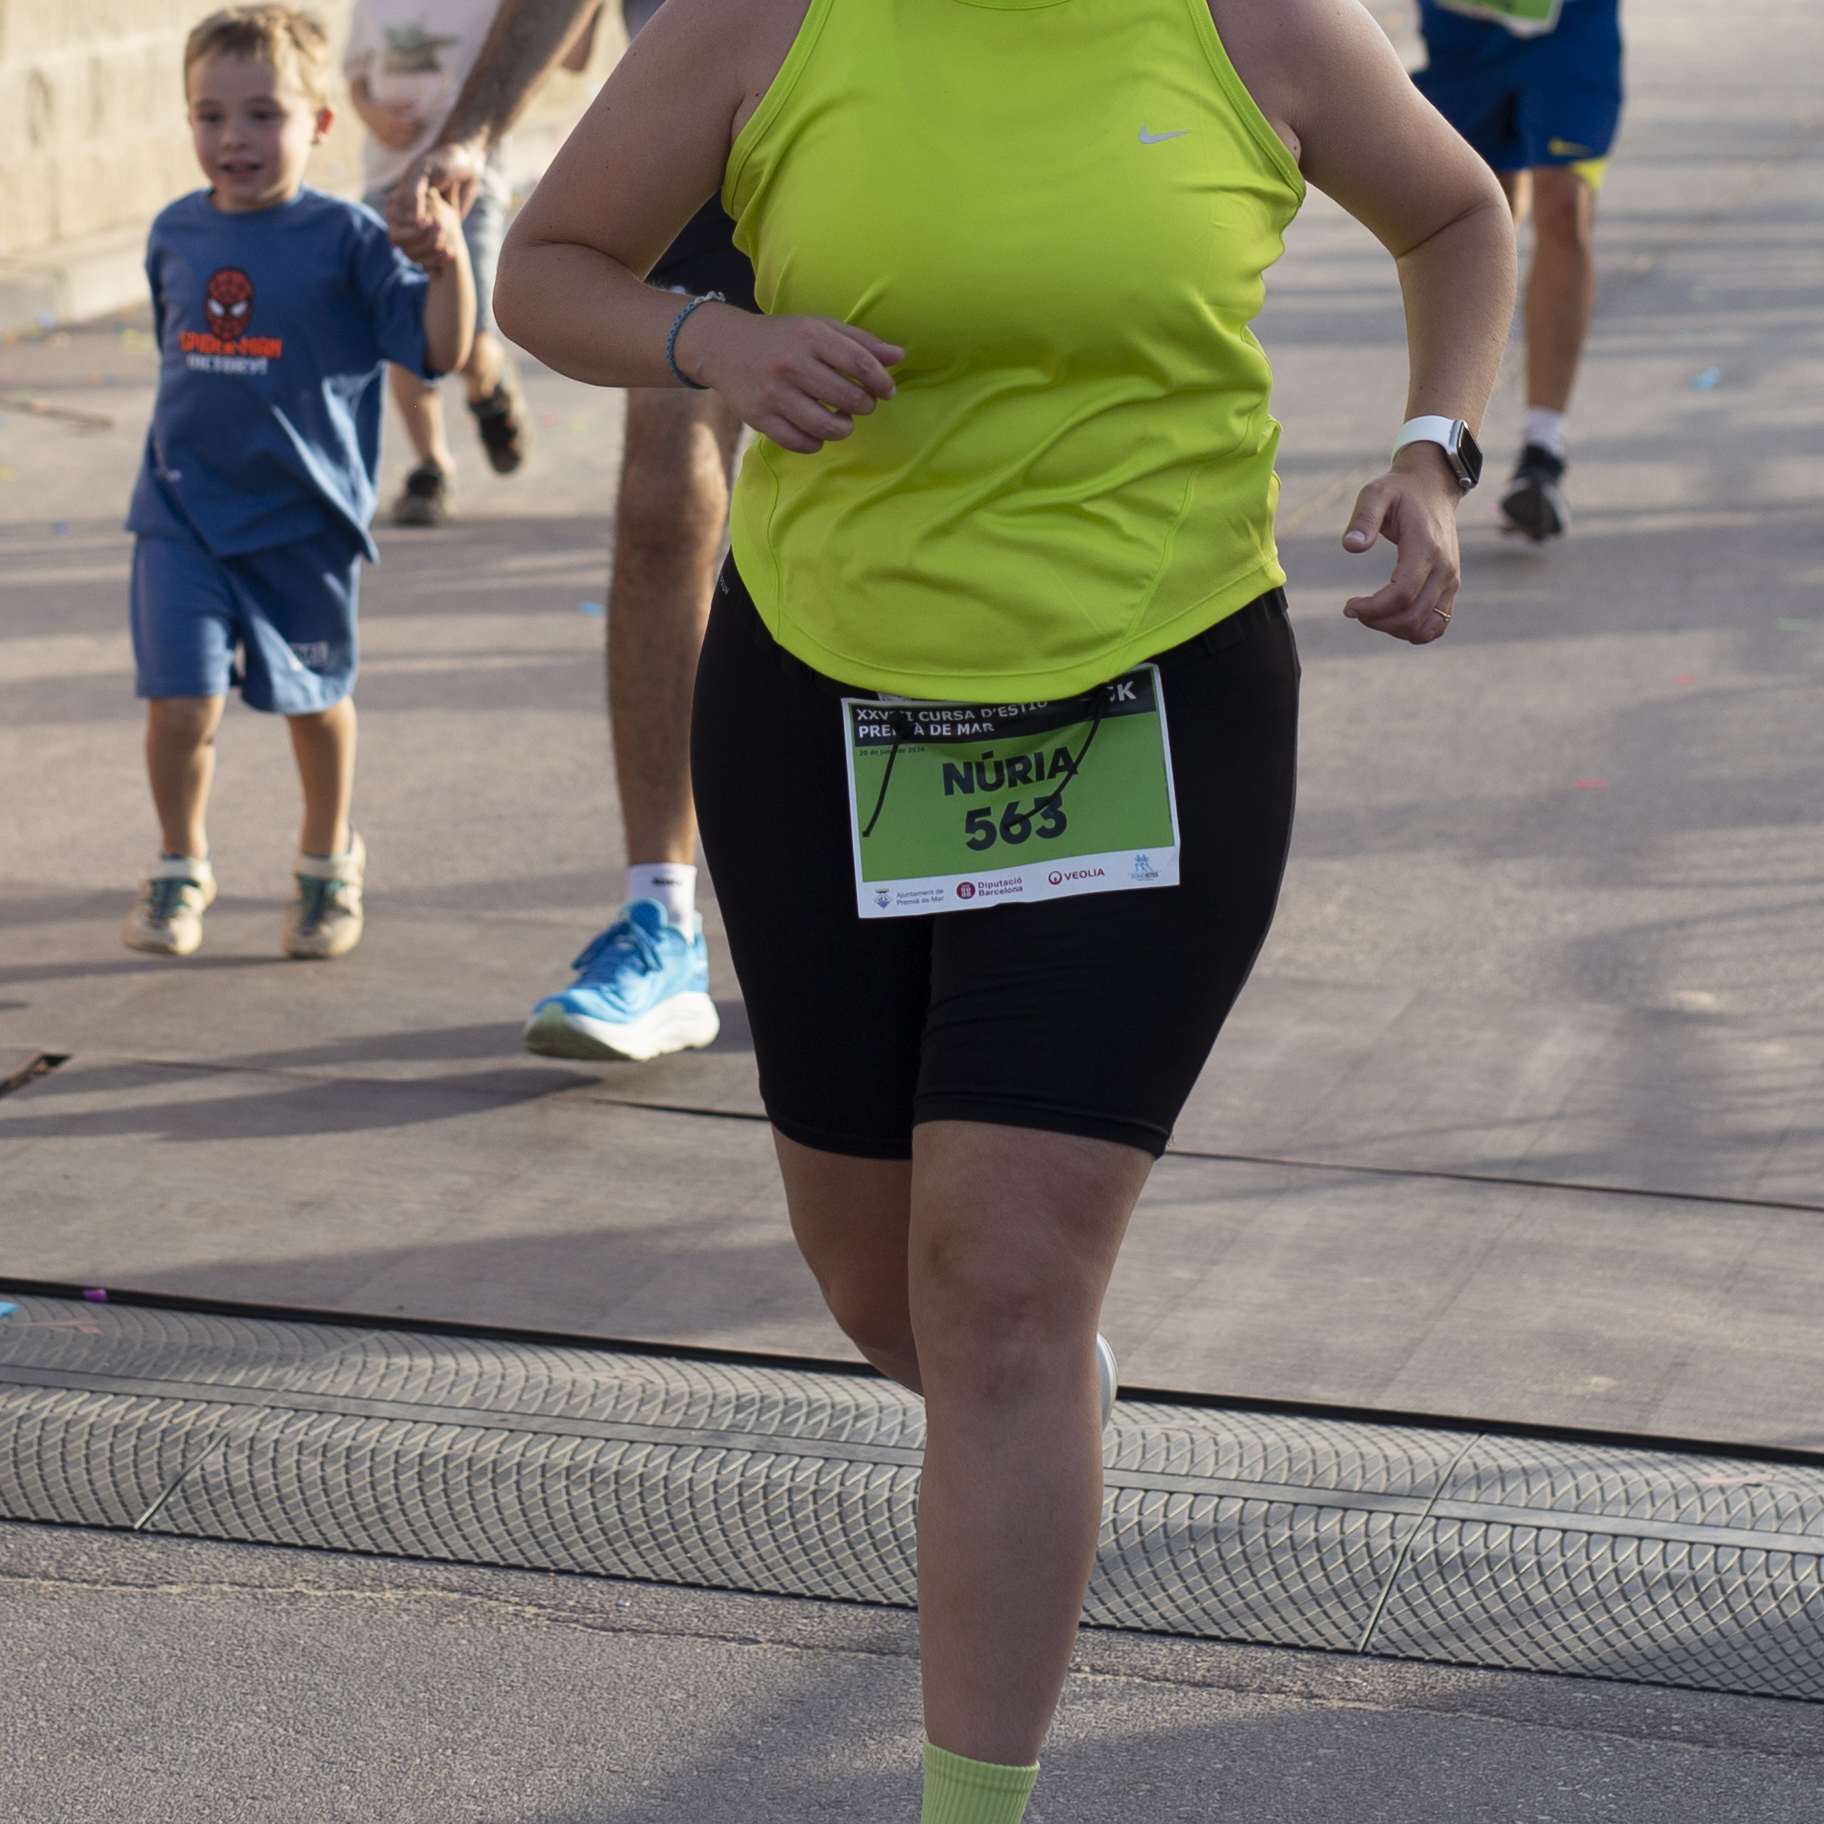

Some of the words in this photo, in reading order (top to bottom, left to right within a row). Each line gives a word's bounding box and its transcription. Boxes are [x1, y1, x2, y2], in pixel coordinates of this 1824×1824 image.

[856, 708, 914, 722] XXVI
[918, 709, 976, 722] CURSA
[859, 722, 925, 738] PREÀ
[929, 723, 952, 736] DE
[957, 723, 995, 736] MAR
[942, 746, 1079, 796] NÚRIA
[964, 794, 1068, 852] 563
[1064, 868, 1106, 881] VEOLIA
[977, 876, 1023, 889] Diputació
[896, 889, 934, 899] Ajuntament
[978, 885, 1024, 897] Barcelona
[931, 896, 945, 904] Mar
